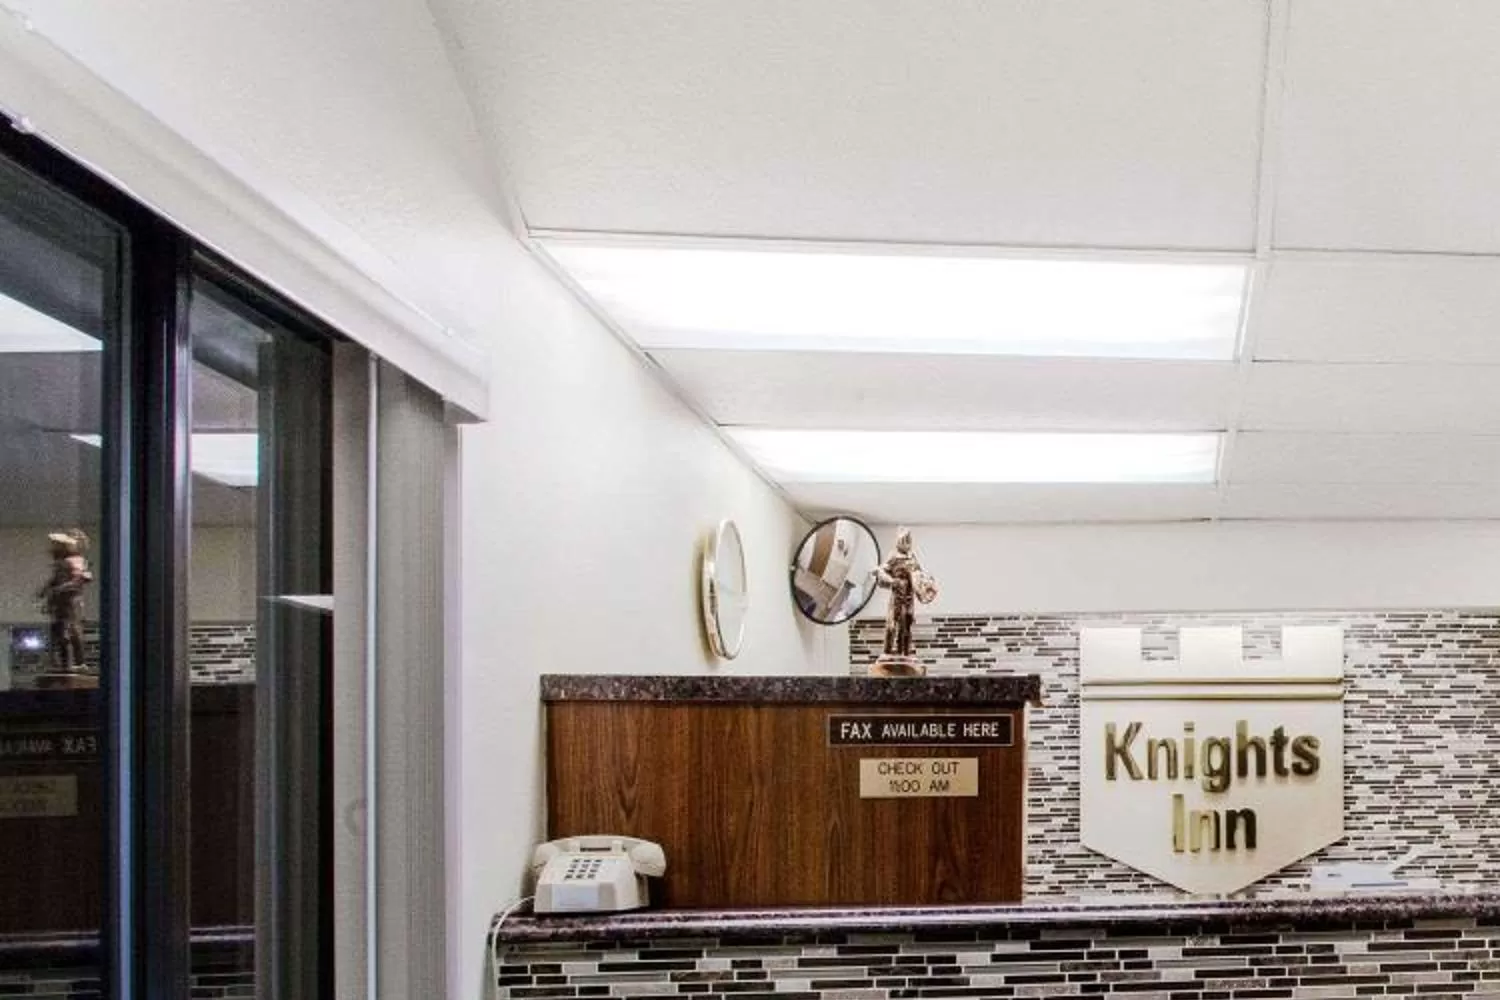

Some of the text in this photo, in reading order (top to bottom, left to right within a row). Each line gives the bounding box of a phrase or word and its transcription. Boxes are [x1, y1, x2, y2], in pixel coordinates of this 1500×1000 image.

[841, 721, 999, 740] FAX AVAILABLE HERE
[1104, 720, 1321, 793] Knights
[877, 762, 960, 775] CHECK OUT
[929, 780, 950, 792] AM
[1172, 794, 1257, 853] Inn
